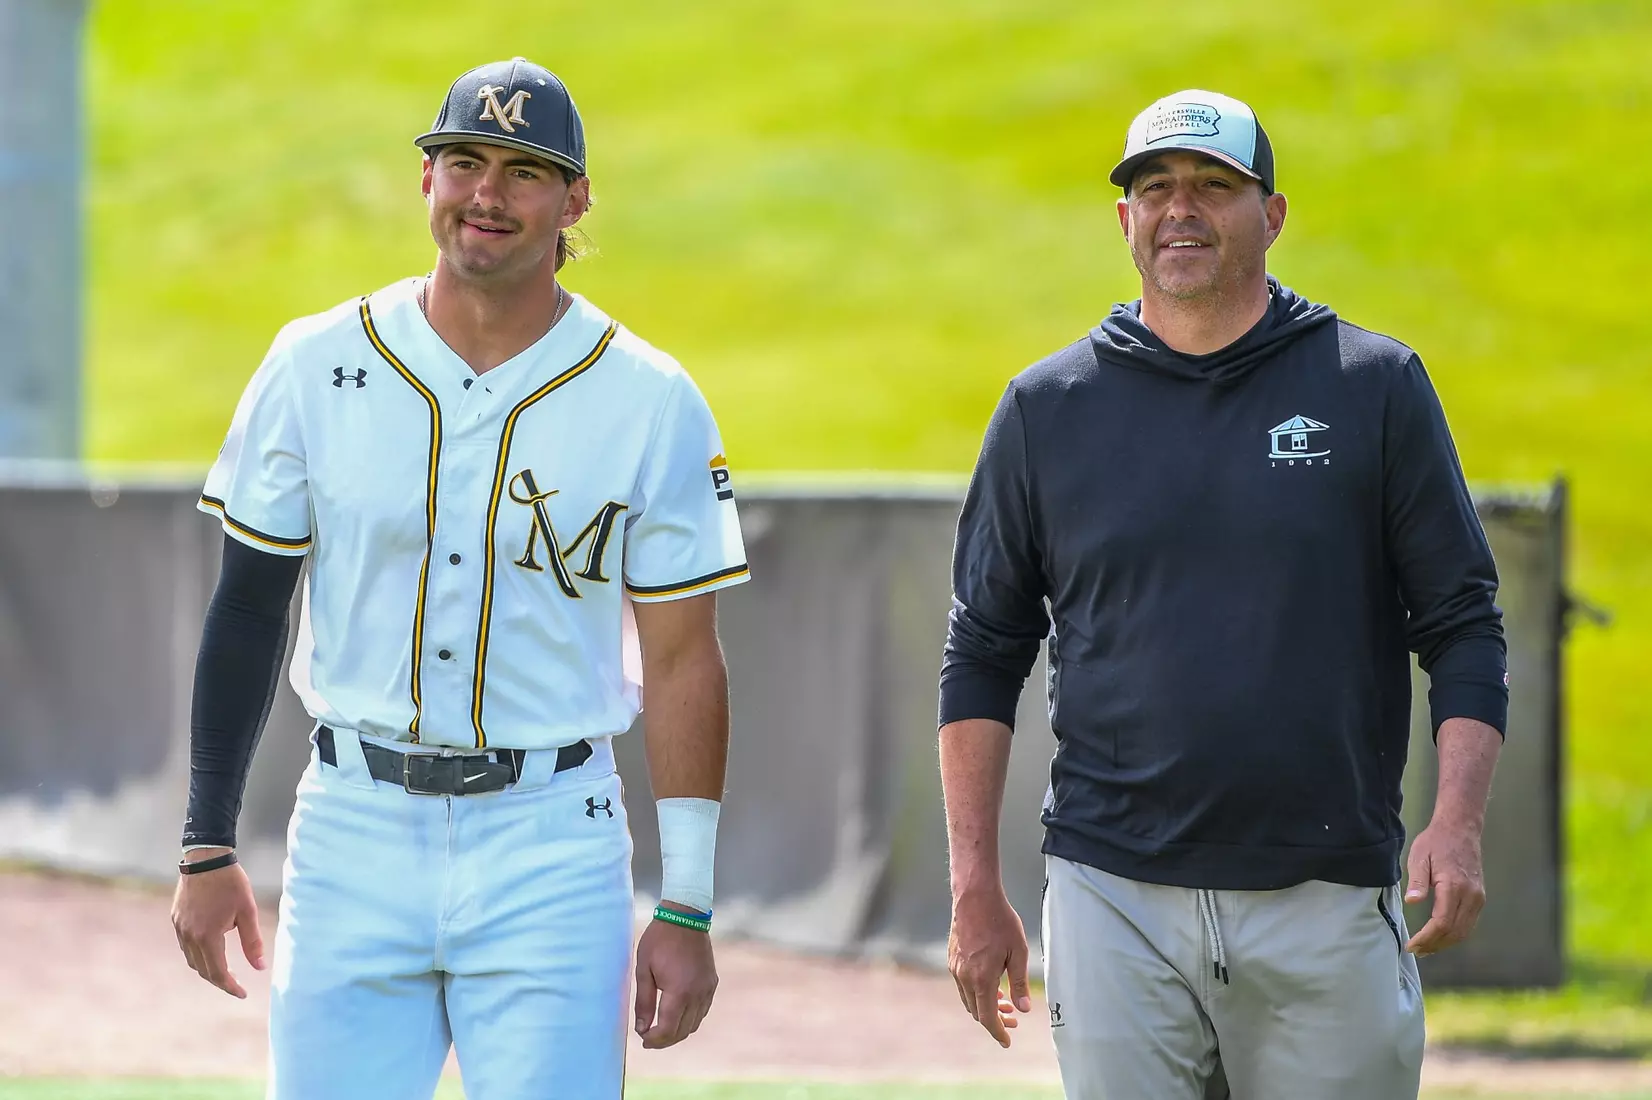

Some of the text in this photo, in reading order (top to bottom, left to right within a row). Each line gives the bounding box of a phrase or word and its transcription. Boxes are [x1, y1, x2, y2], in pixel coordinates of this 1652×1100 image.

[478, 83, 531, 132] M
[1152, 115, 1211, 128] MARAUDERS
[509, 469, 629, 599] M
[659, 911, 694, 926] SHAMROCK
